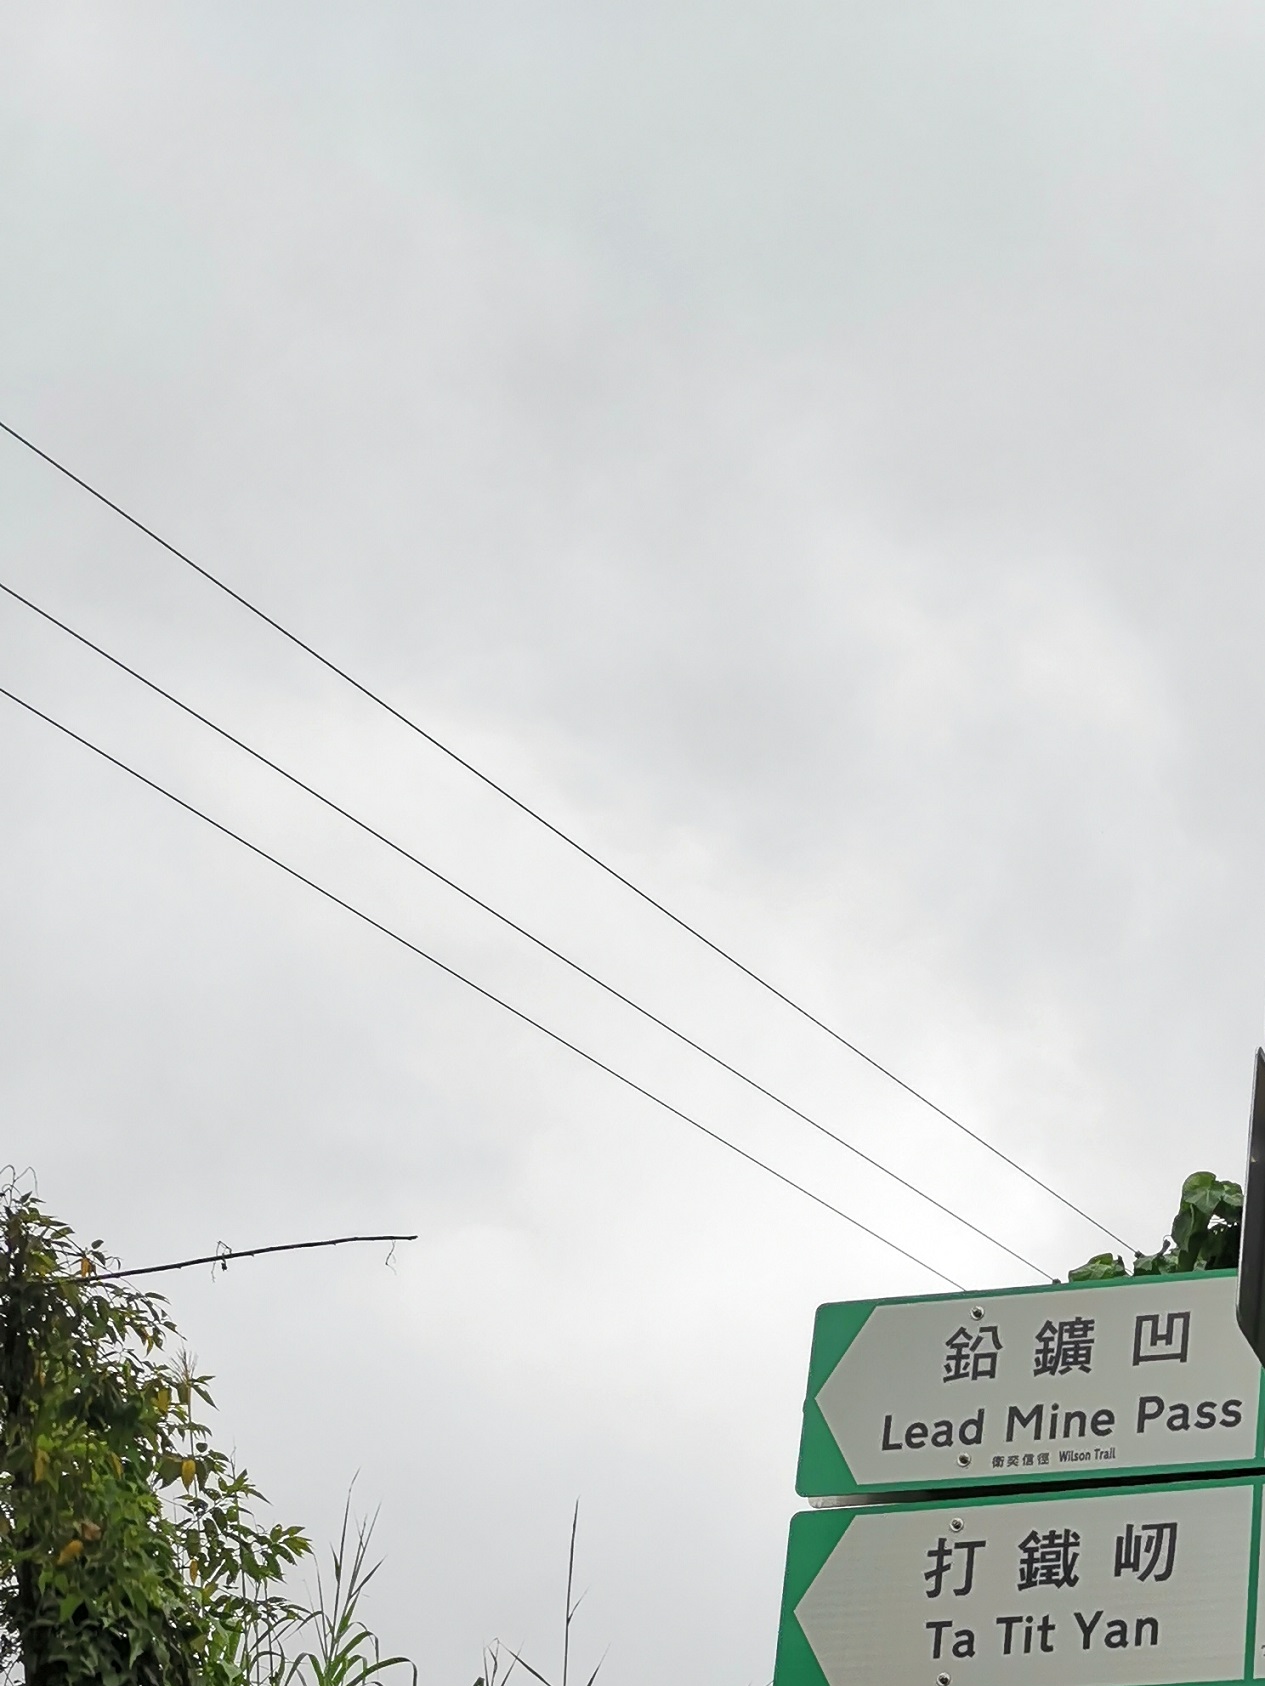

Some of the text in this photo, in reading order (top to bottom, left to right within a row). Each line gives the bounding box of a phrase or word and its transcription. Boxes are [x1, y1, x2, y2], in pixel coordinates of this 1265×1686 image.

[881, 1396, 1243, 1451] Lead Mine Pass
[1059, 1447, 1116, 1462] Wilson Trail
[924, 1522, 1178, 1598] 打鐵屻
[926, 1610, 1159, 1659] Ta Tit Yan
